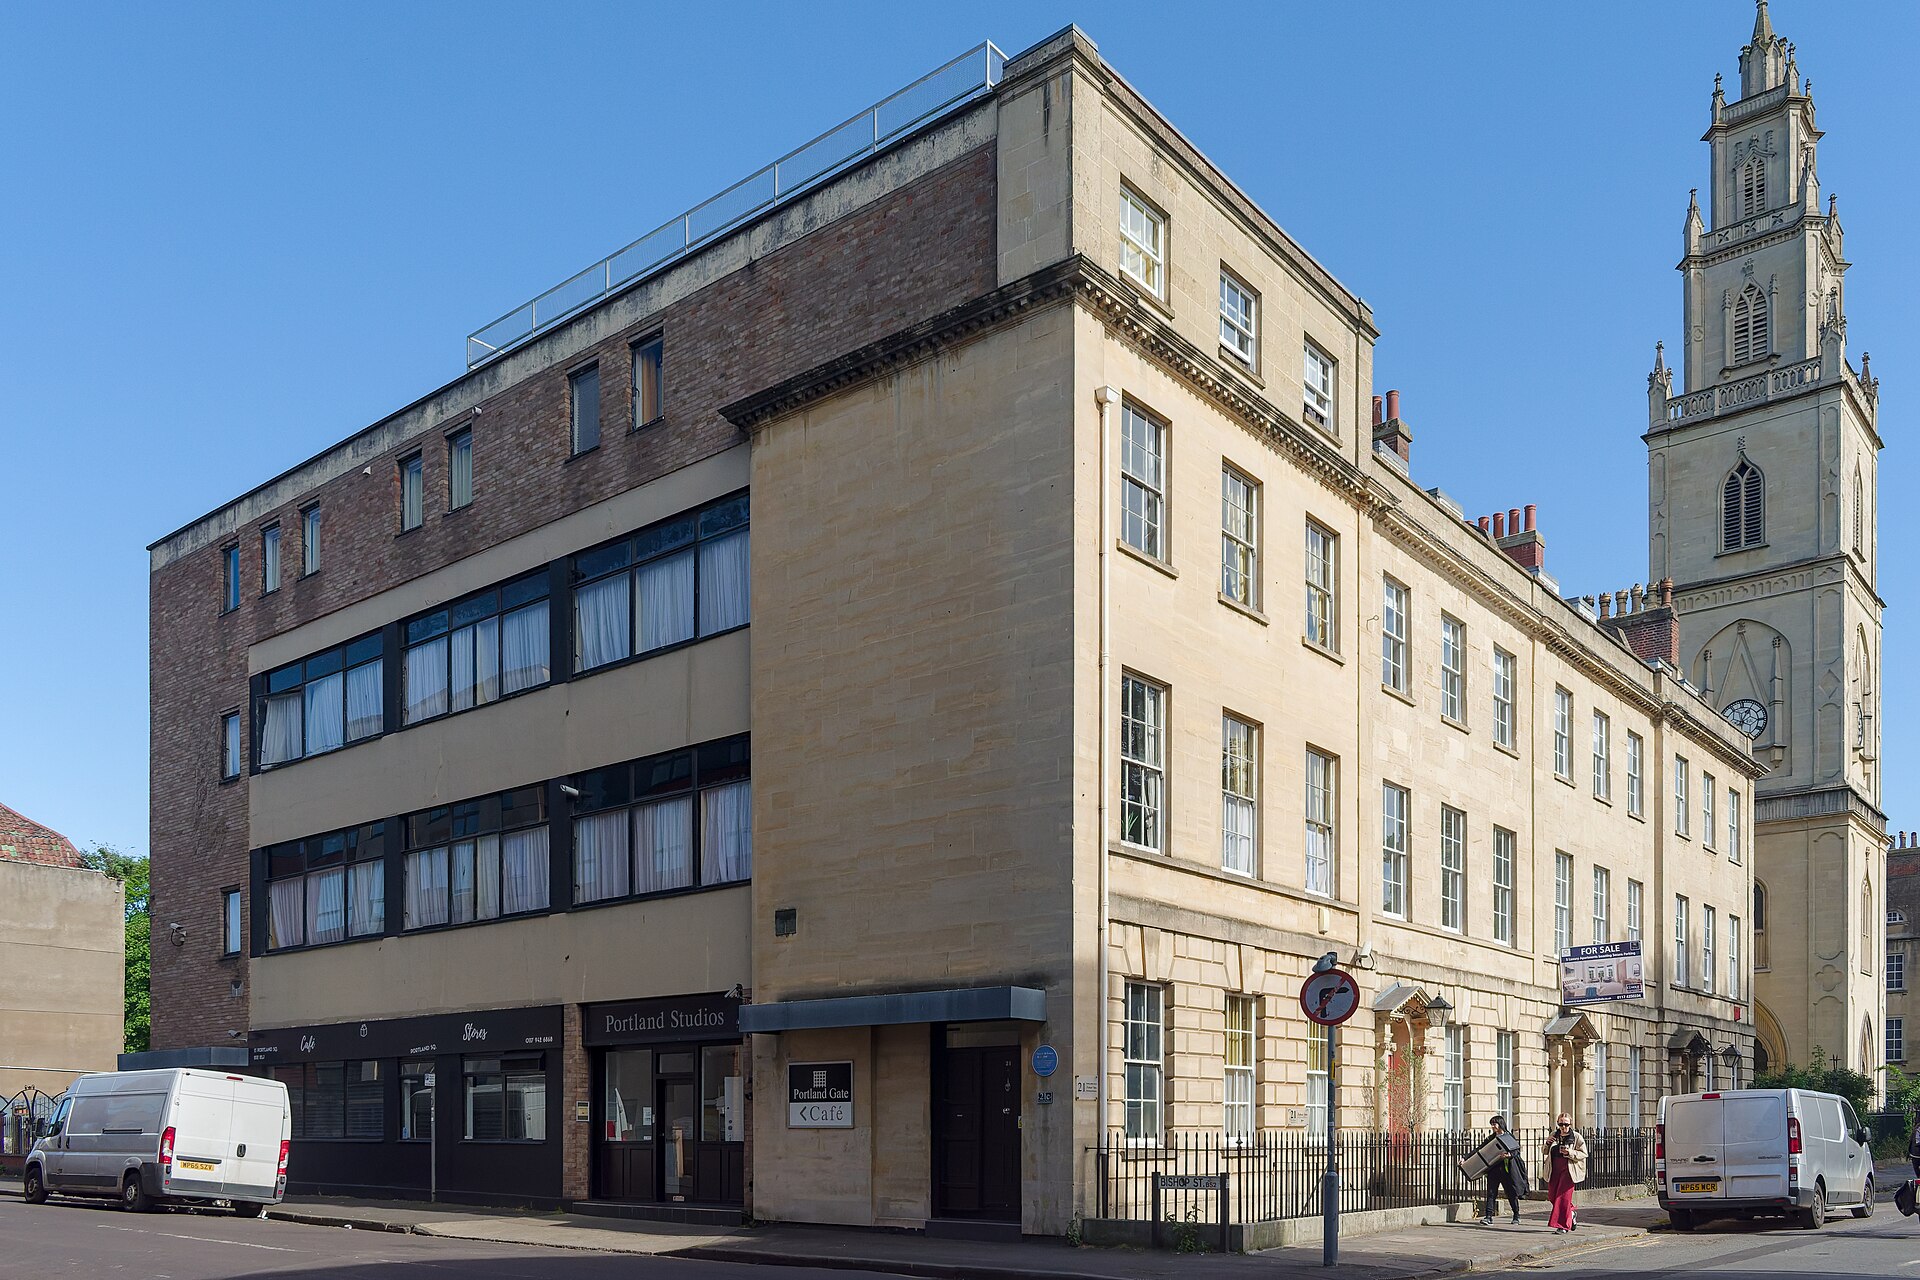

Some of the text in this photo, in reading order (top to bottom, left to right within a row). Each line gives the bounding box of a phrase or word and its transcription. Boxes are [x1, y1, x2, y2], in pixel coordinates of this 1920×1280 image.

[1581, 945, 1620, 956] FOR SALE
[605, 1008, 724, 1033] Portland Studios
[463, 1023, 488, 1041] Stores
[300, 1035, 316, 1053] Café
[410, 1045, 430, 1054] PORTLAND
[793, 1087, 849, 1100] Portland Gate
[1077, 1082, 1086, 1093] 21
[809, 1105, 843, 1121] Café
[1160, 1177, 1190, 1187] BISHOP
[1193, 1178, 1205, 1188] ST.
[1680, 1183, 1716, 1191] WP65 WCR
